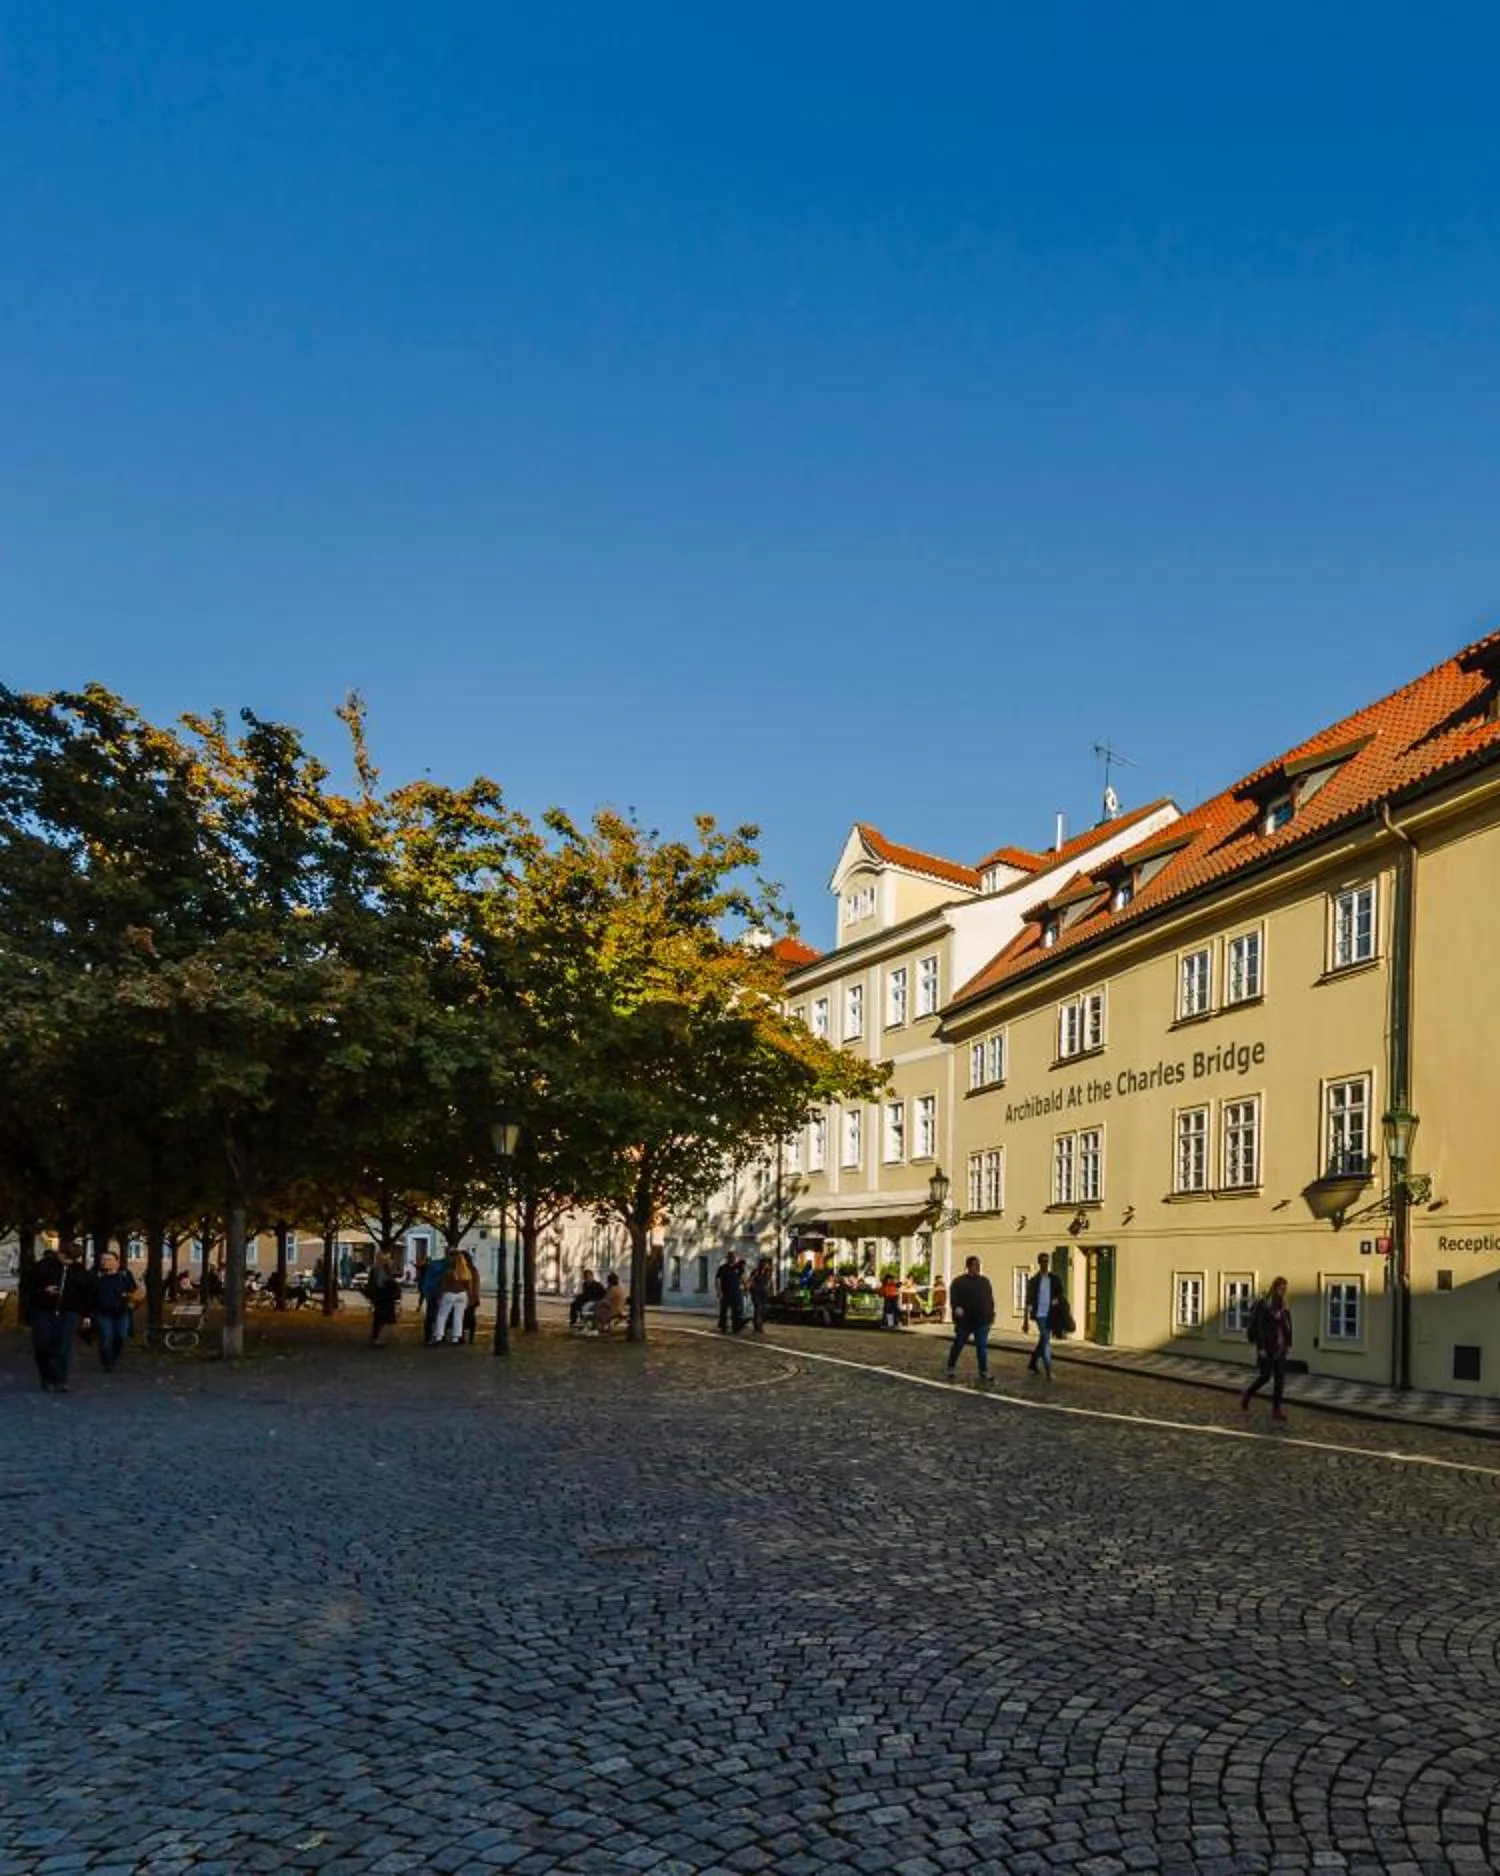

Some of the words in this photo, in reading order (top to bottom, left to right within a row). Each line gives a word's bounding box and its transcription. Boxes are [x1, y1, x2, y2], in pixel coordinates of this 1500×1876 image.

[1005, 1090, 1062, 1124] Archibald
[1066, 1085, 1083, 1106] At
[1087, 1080, 1111, 1104] the
[1117, 1060, 1185, 1096] Charles
[1192, 1041, 1265, 1080] Bridge
